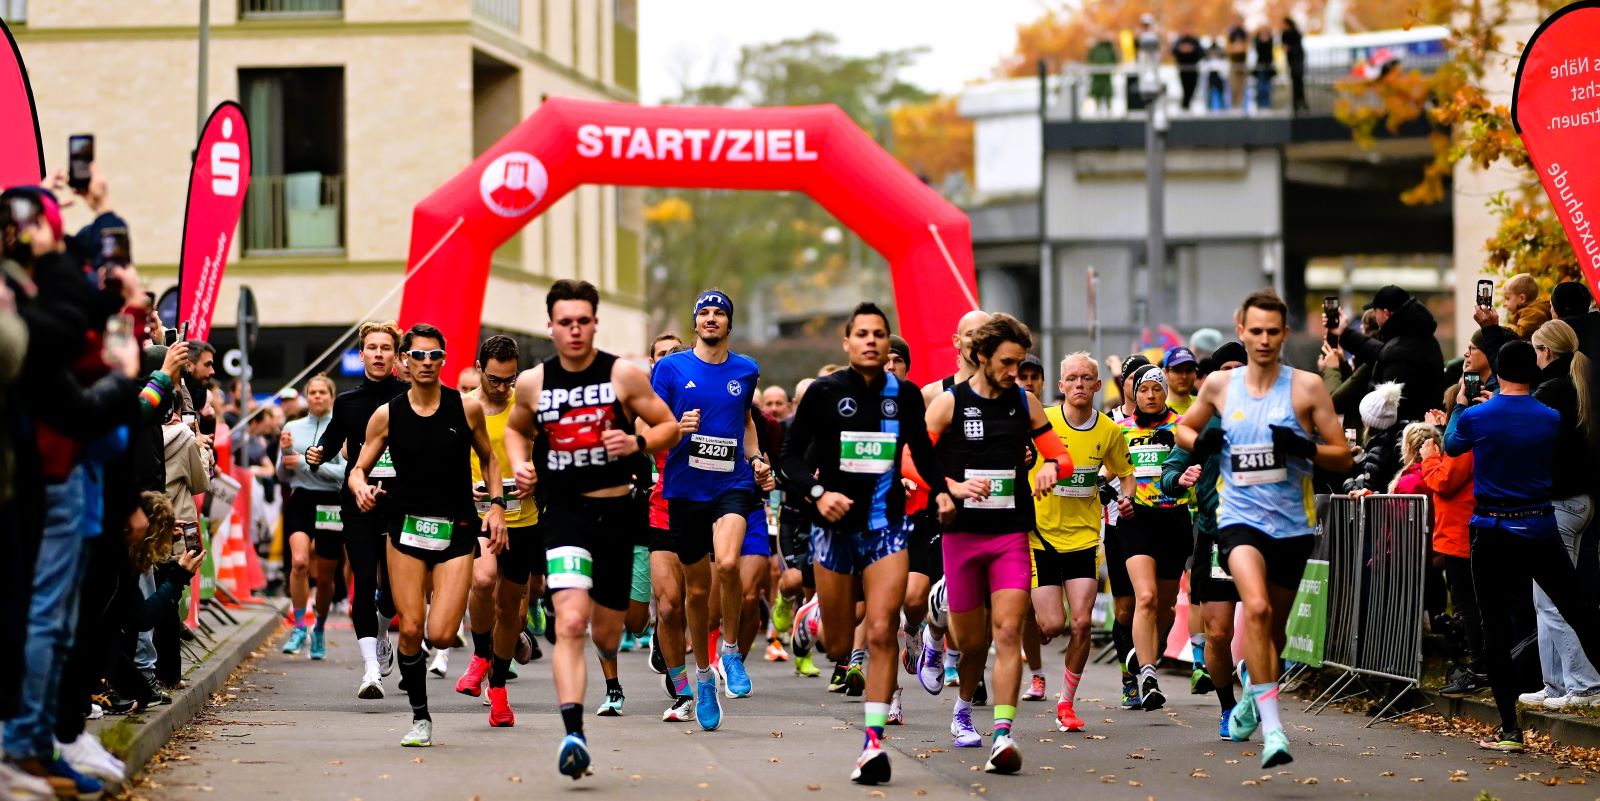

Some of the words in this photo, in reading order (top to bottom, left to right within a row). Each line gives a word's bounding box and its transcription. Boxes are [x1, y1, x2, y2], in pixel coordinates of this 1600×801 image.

[576, 124, 818, 162] START/ZIEL
[188, 256, 211, 335] Sparkasse
[538, 382, 616, 412] SPEED
[698, 443, 728, 457] 2420
[855, 442, 882, 456] 640
[378, 453, 393, 464] 42
[547, 447, 618, 471] SPEE
[1138, 452, 1158, 463] 228
[1238, 452, 1275, 468] 2418
[1070, 473, 1085, 484] 36
[415, 520, 439, 535] 666
[564, 556, 580, 571] 51
